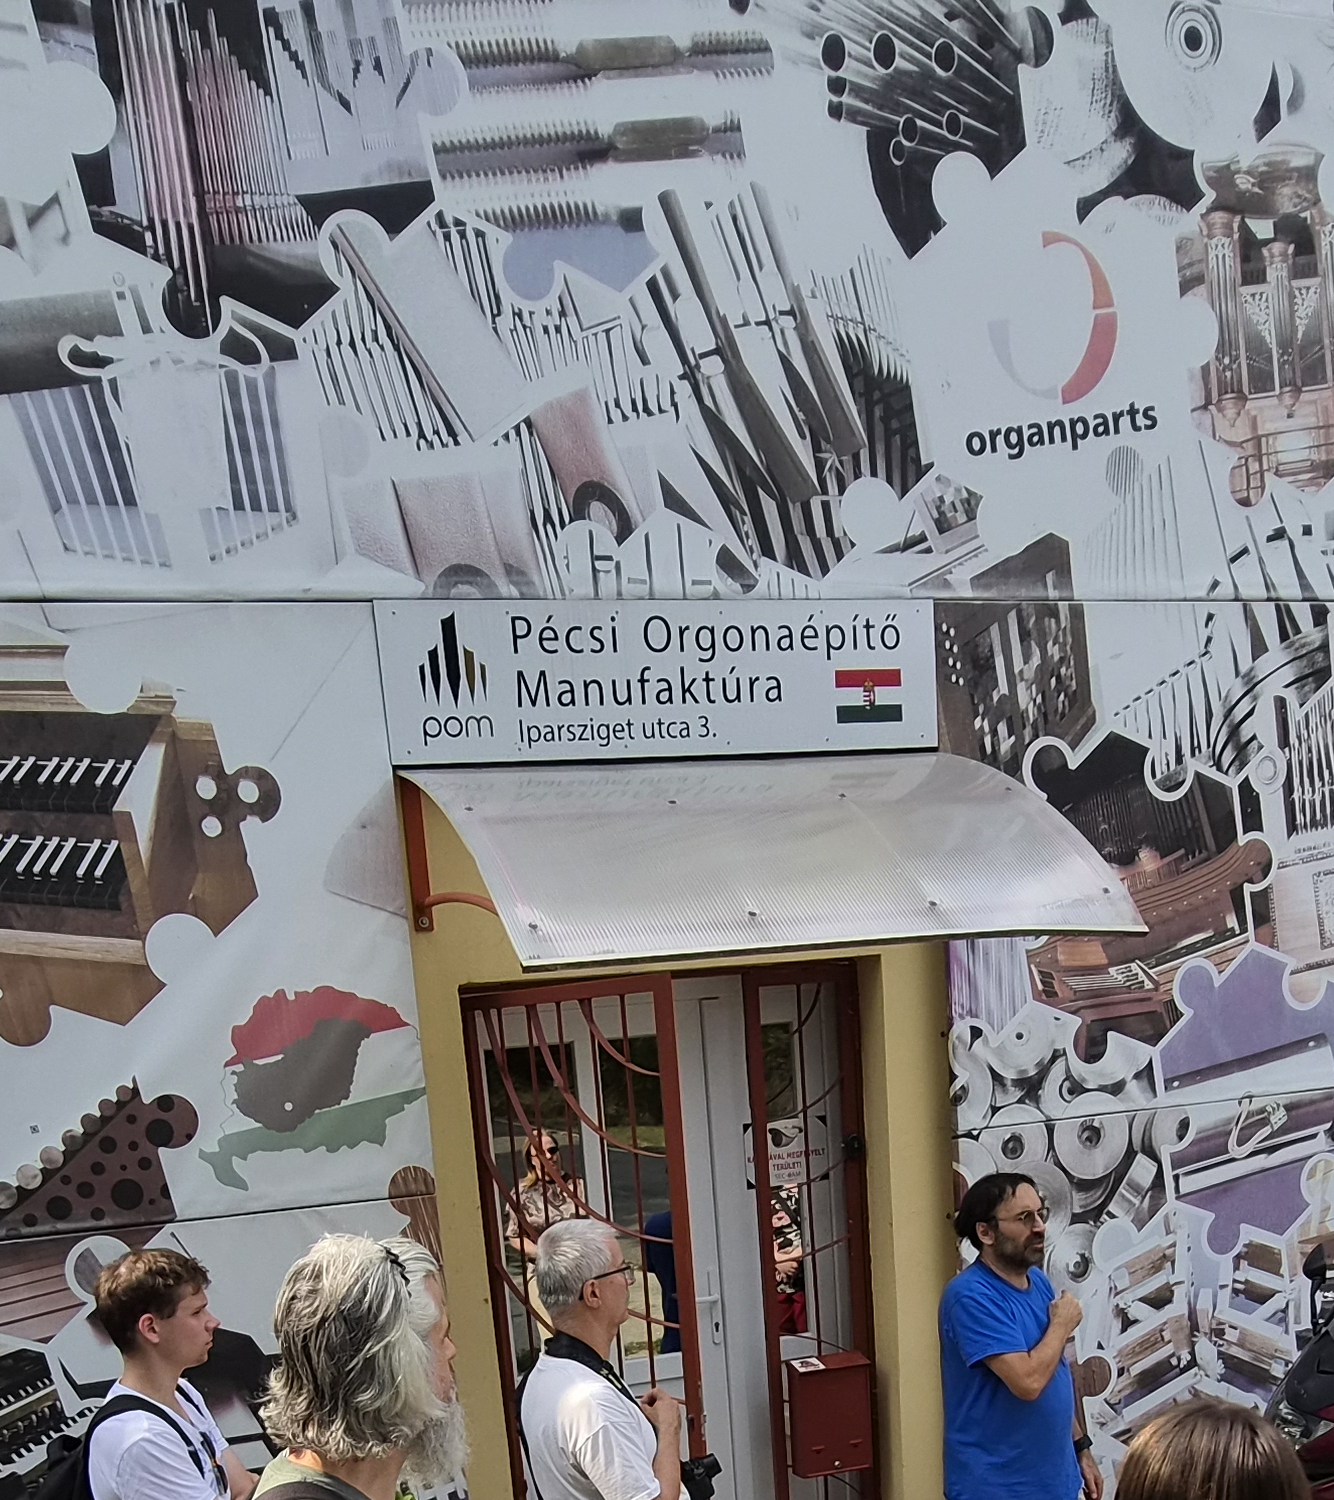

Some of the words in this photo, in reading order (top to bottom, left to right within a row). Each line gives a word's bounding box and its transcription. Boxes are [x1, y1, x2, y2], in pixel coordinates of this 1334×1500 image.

[965, 401, 1158, 459] organparts
[511, 614, 619, 655] Pécsi
[643, 613, 902, 663] Orgonaépítő
[517, 666, 784, 709] Manufaktúra
[422, 714, 495, 744] pom
[518, 717, 636, 748] Iparsziget
[642, 718, 692, 740] utca
[697, 716, 718, 739] 3.
